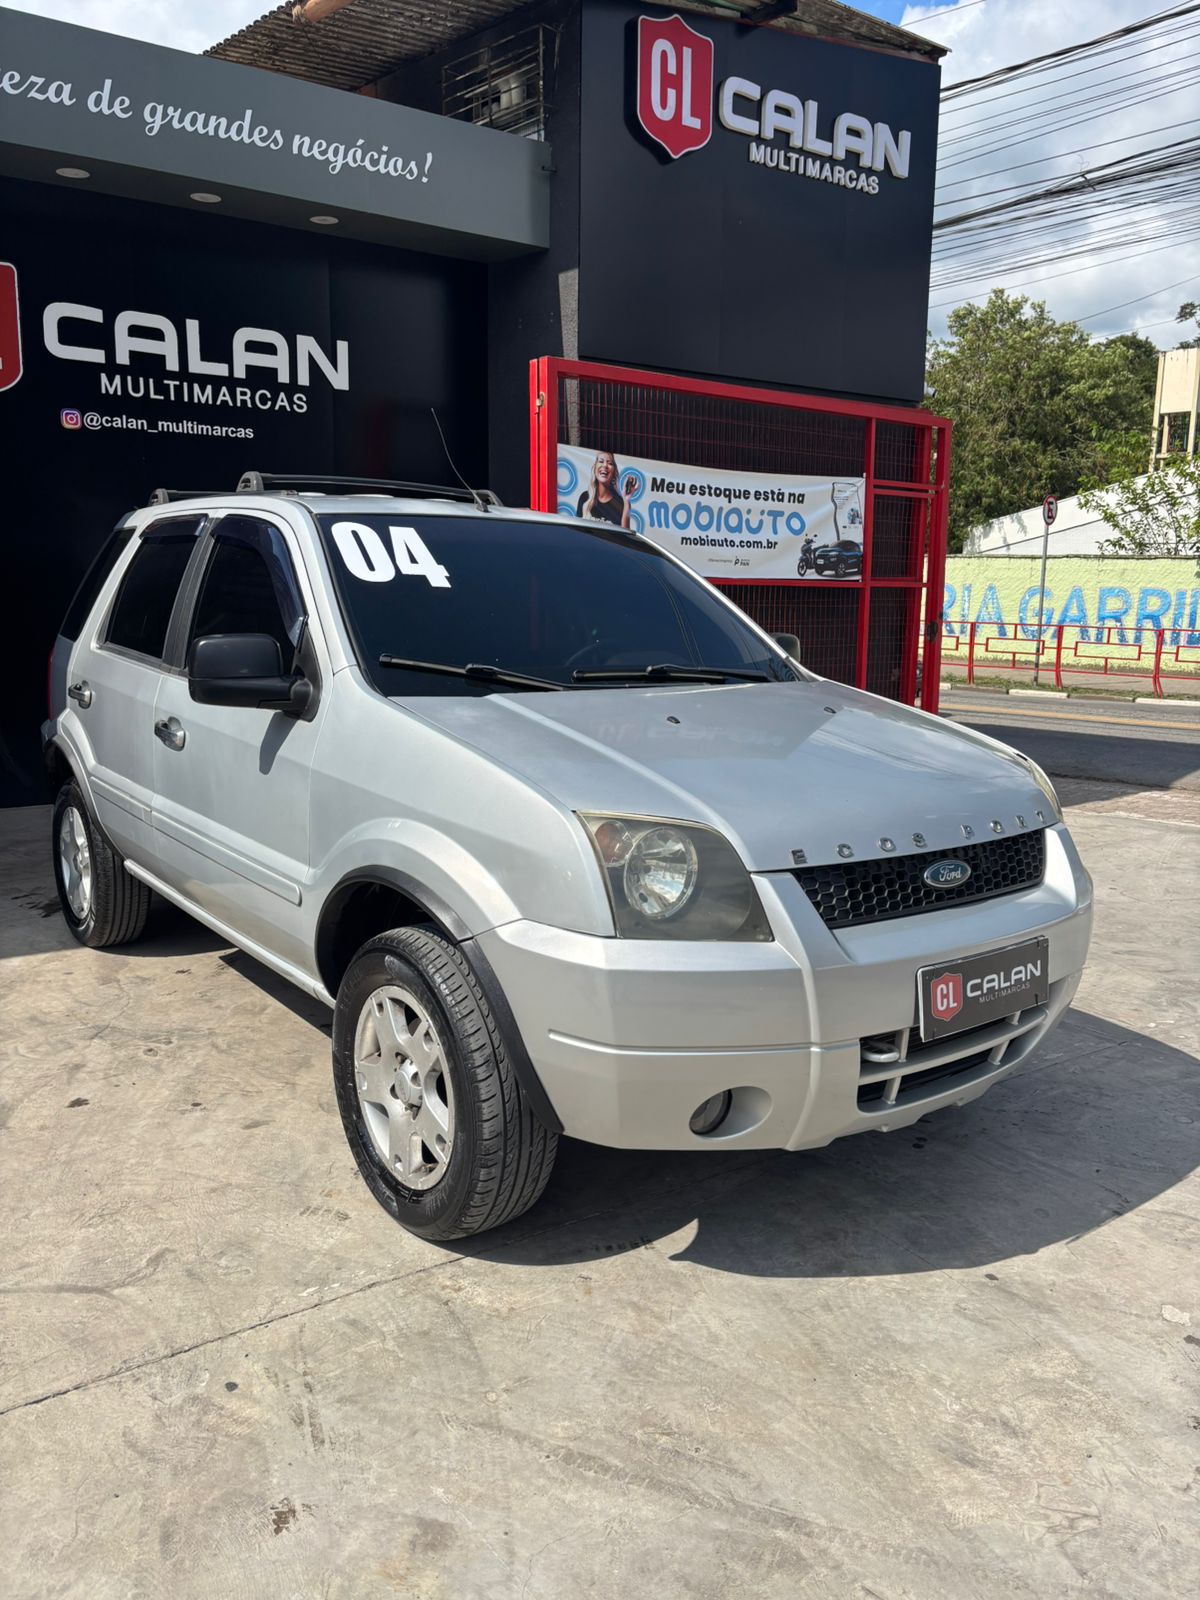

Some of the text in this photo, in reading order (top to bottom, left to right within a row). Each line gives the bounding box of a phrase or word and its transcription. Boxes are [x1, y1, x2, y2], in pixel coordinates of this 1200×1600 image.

[651, 38, 702, 130] CL
[0, 70, 433, 183] eza de grandes negócios!
[719, 76, 911, 179] CALAN
[749, 142, 880, 195] MULTIMARCAS
[43, 302, 350, 391] CALAN
[101, 373, 309, 414] MULTIMARCAS
[83, 412, 254, 439] @calan_multimarcas
[651, 477, 805, 504] Meu estoque está na
[331, 521, 452, 588] 04
[680, 535, 778, 550] mobiauto.com.br
[939, 864, 962, 882] Ford
[936, 959, 1041, 1011] CL CALAN
[979, 981, 1031, 1003] MULTIMARCAS
